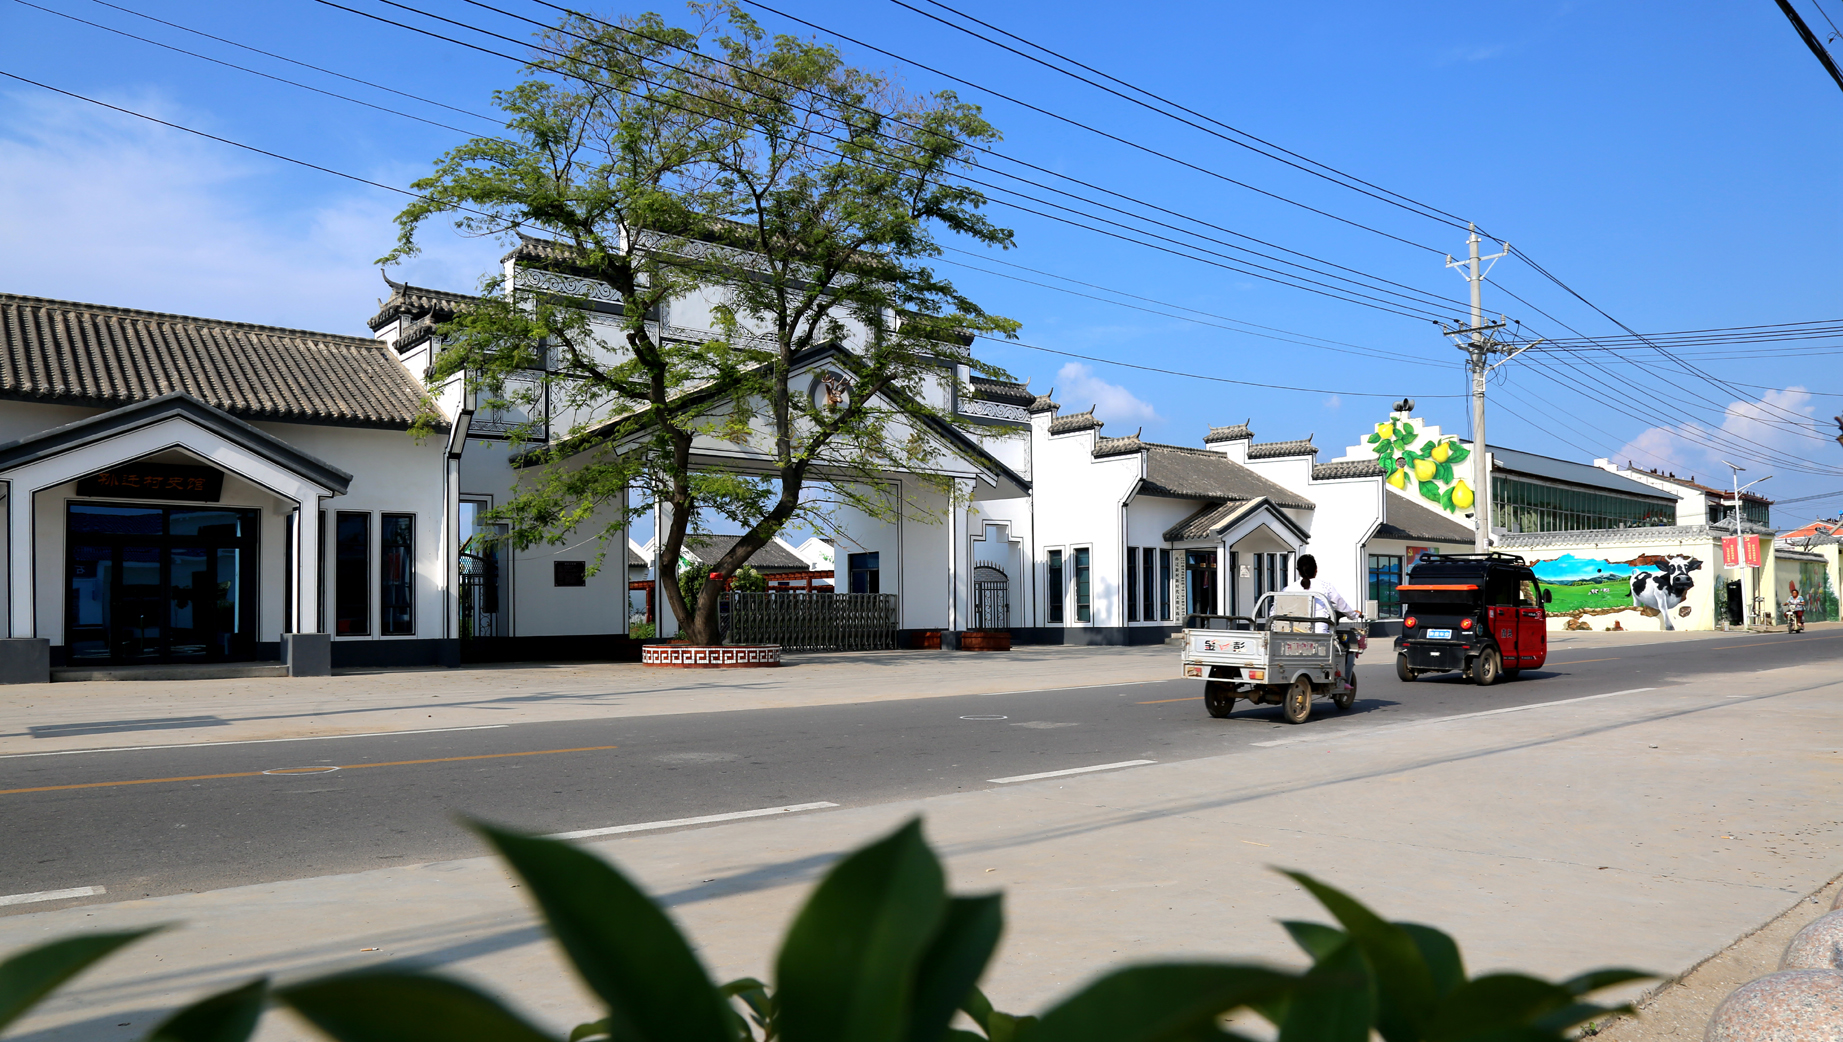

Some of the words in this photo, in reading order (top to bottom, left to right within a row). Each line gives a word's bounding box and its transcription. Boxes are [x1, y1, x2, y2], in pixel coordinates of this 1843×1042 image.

[97, 473, 206, 491] 孙迁村史馆
